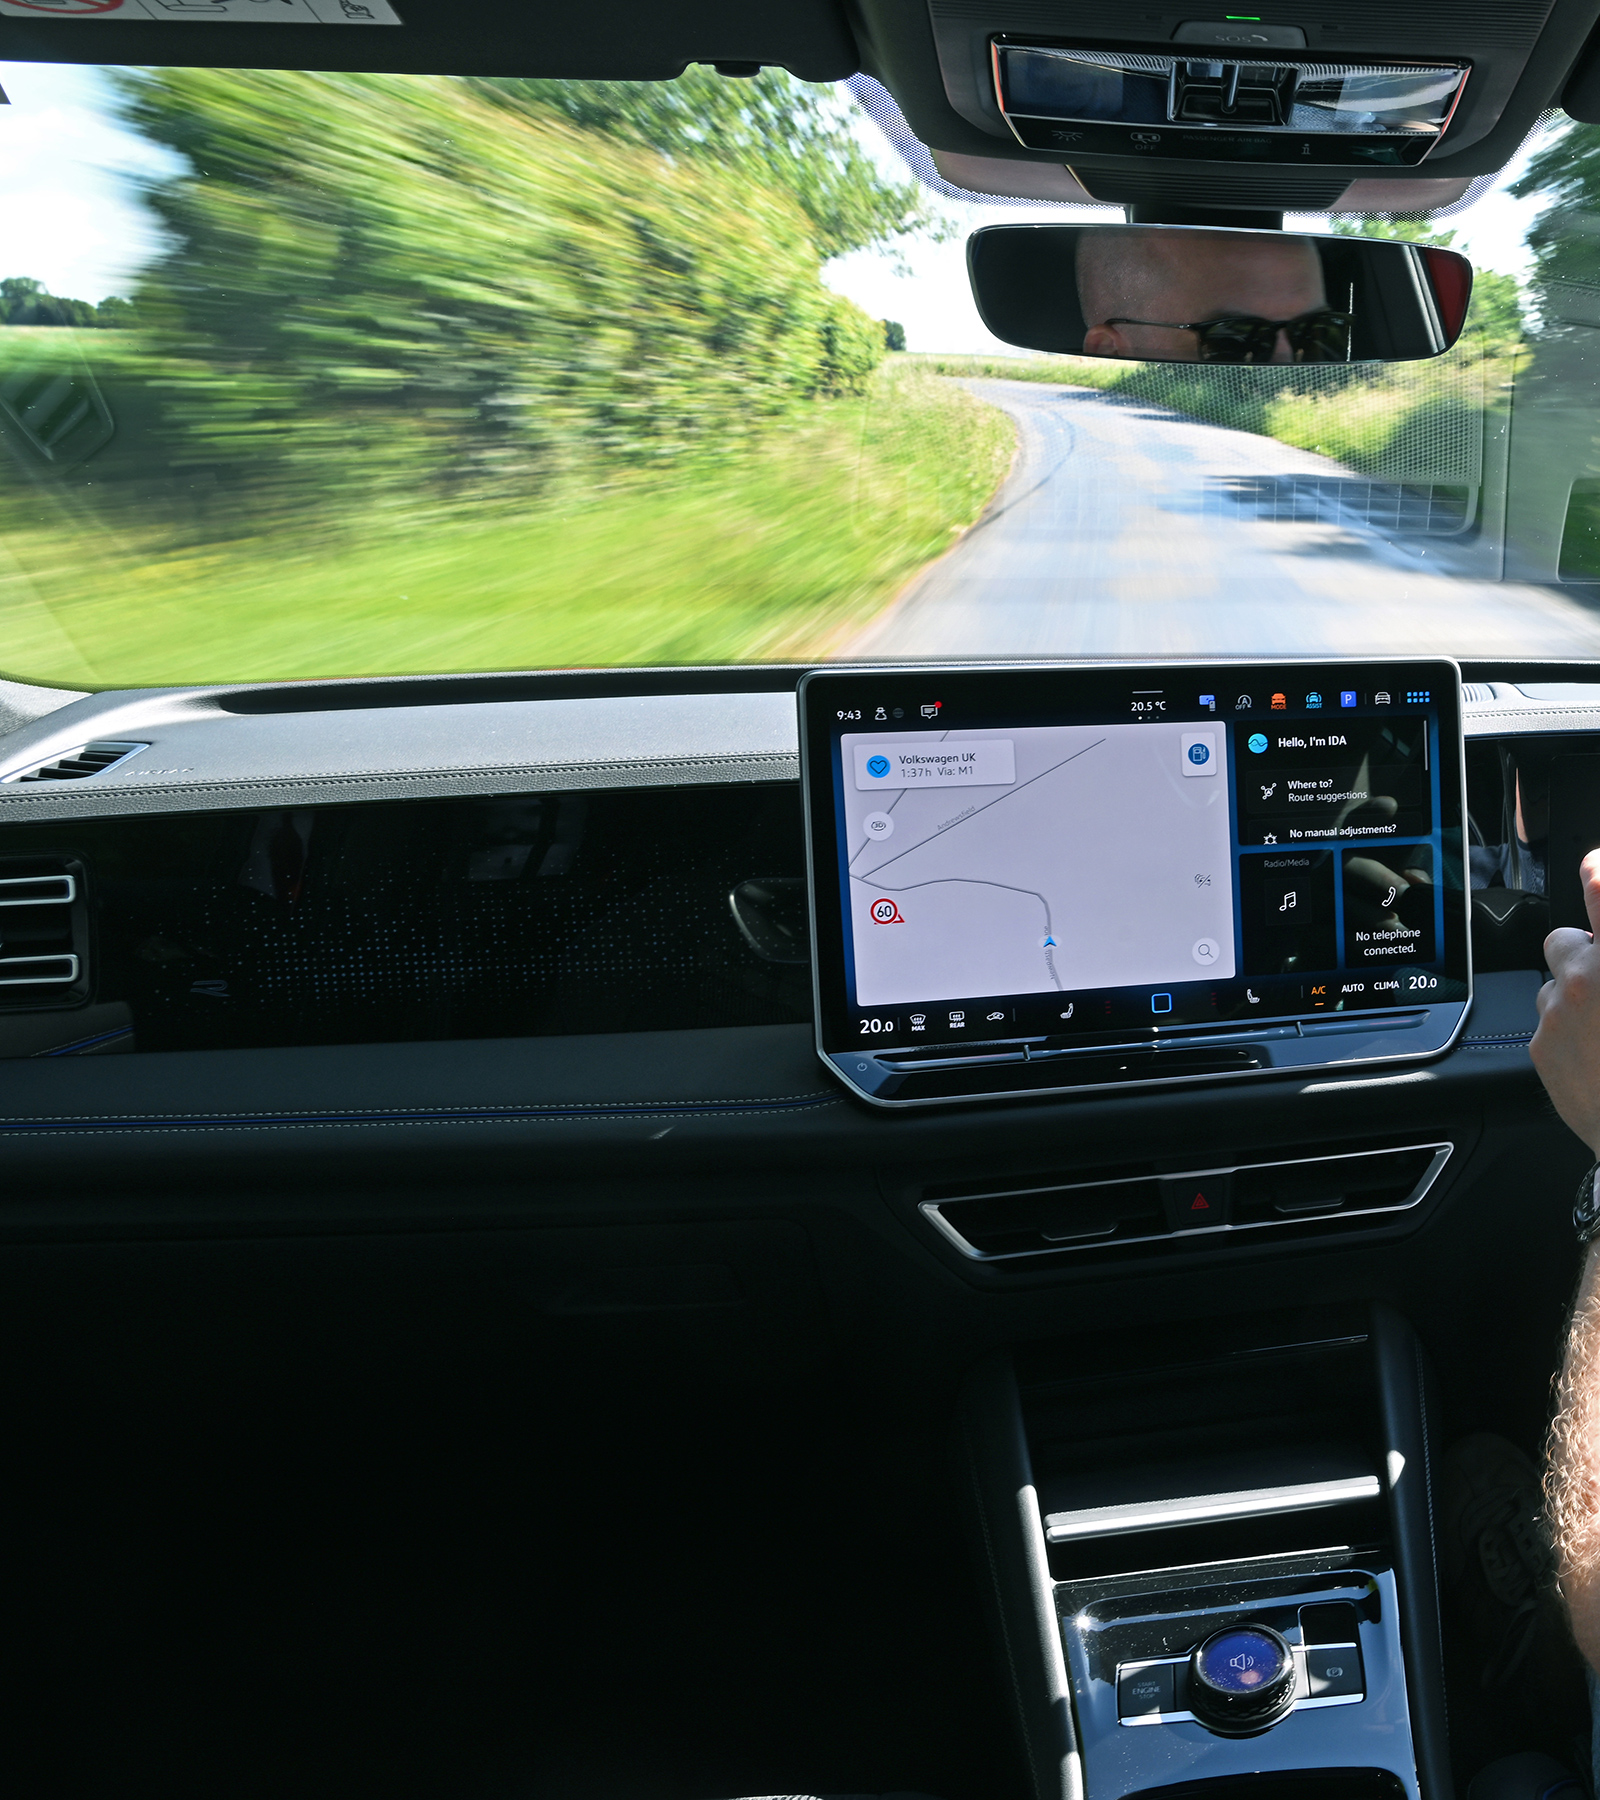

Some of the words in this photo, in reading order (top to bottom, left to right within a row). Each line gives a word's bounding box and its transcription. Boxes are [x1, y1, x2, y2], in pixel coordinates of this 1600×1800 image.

[1215, 34, 1251, 43] SOS
[1131, 701, 1153, 712] 20.5
[1155, 701, 1167, 711] °C
[836, 710, 862, 720] 9:43
[1278, 737, 1307, 749] Hello,
[1310, 736, 1326, 747] I'm
[1328, 735, 1347, 746] IDA
[898, 754, 960, 766] Volkswagen
[961, 753, 977, 763] UK
[937, 767, 956, 776] Via:
[958, 766, 974, 775] M1
[1287, 780, 1317, 790] Where
[1319, 779, 1333, 789] to?
[1288, 792, 1315, 803] Route
[1316, 790, 1368, 803] suggestions
[1290, 829, 1303, 839] No
[1305, 827, 1338, 837] manual
[1339, 824, 1397, 838] adjustments?
[1263, 858, 1310, 869] Radio/Media
[876, 905, 892, 918] 60
[1355, 931, 1371, 942] No
[1373, 928, 1421, 942] telephone
[1363, 943, 1417, 956] connected.
[1311, 985, 1326, 995] A/C
[1341, 983, 1365, 993] AUTO
[1373, 980, 1400, 991] CLIMA
[1408, 975, 1438, 990] 20.0
[859, 1018, 894, 1034] 20.0
[1132, 1686, 1160, 1695] ENGINE
